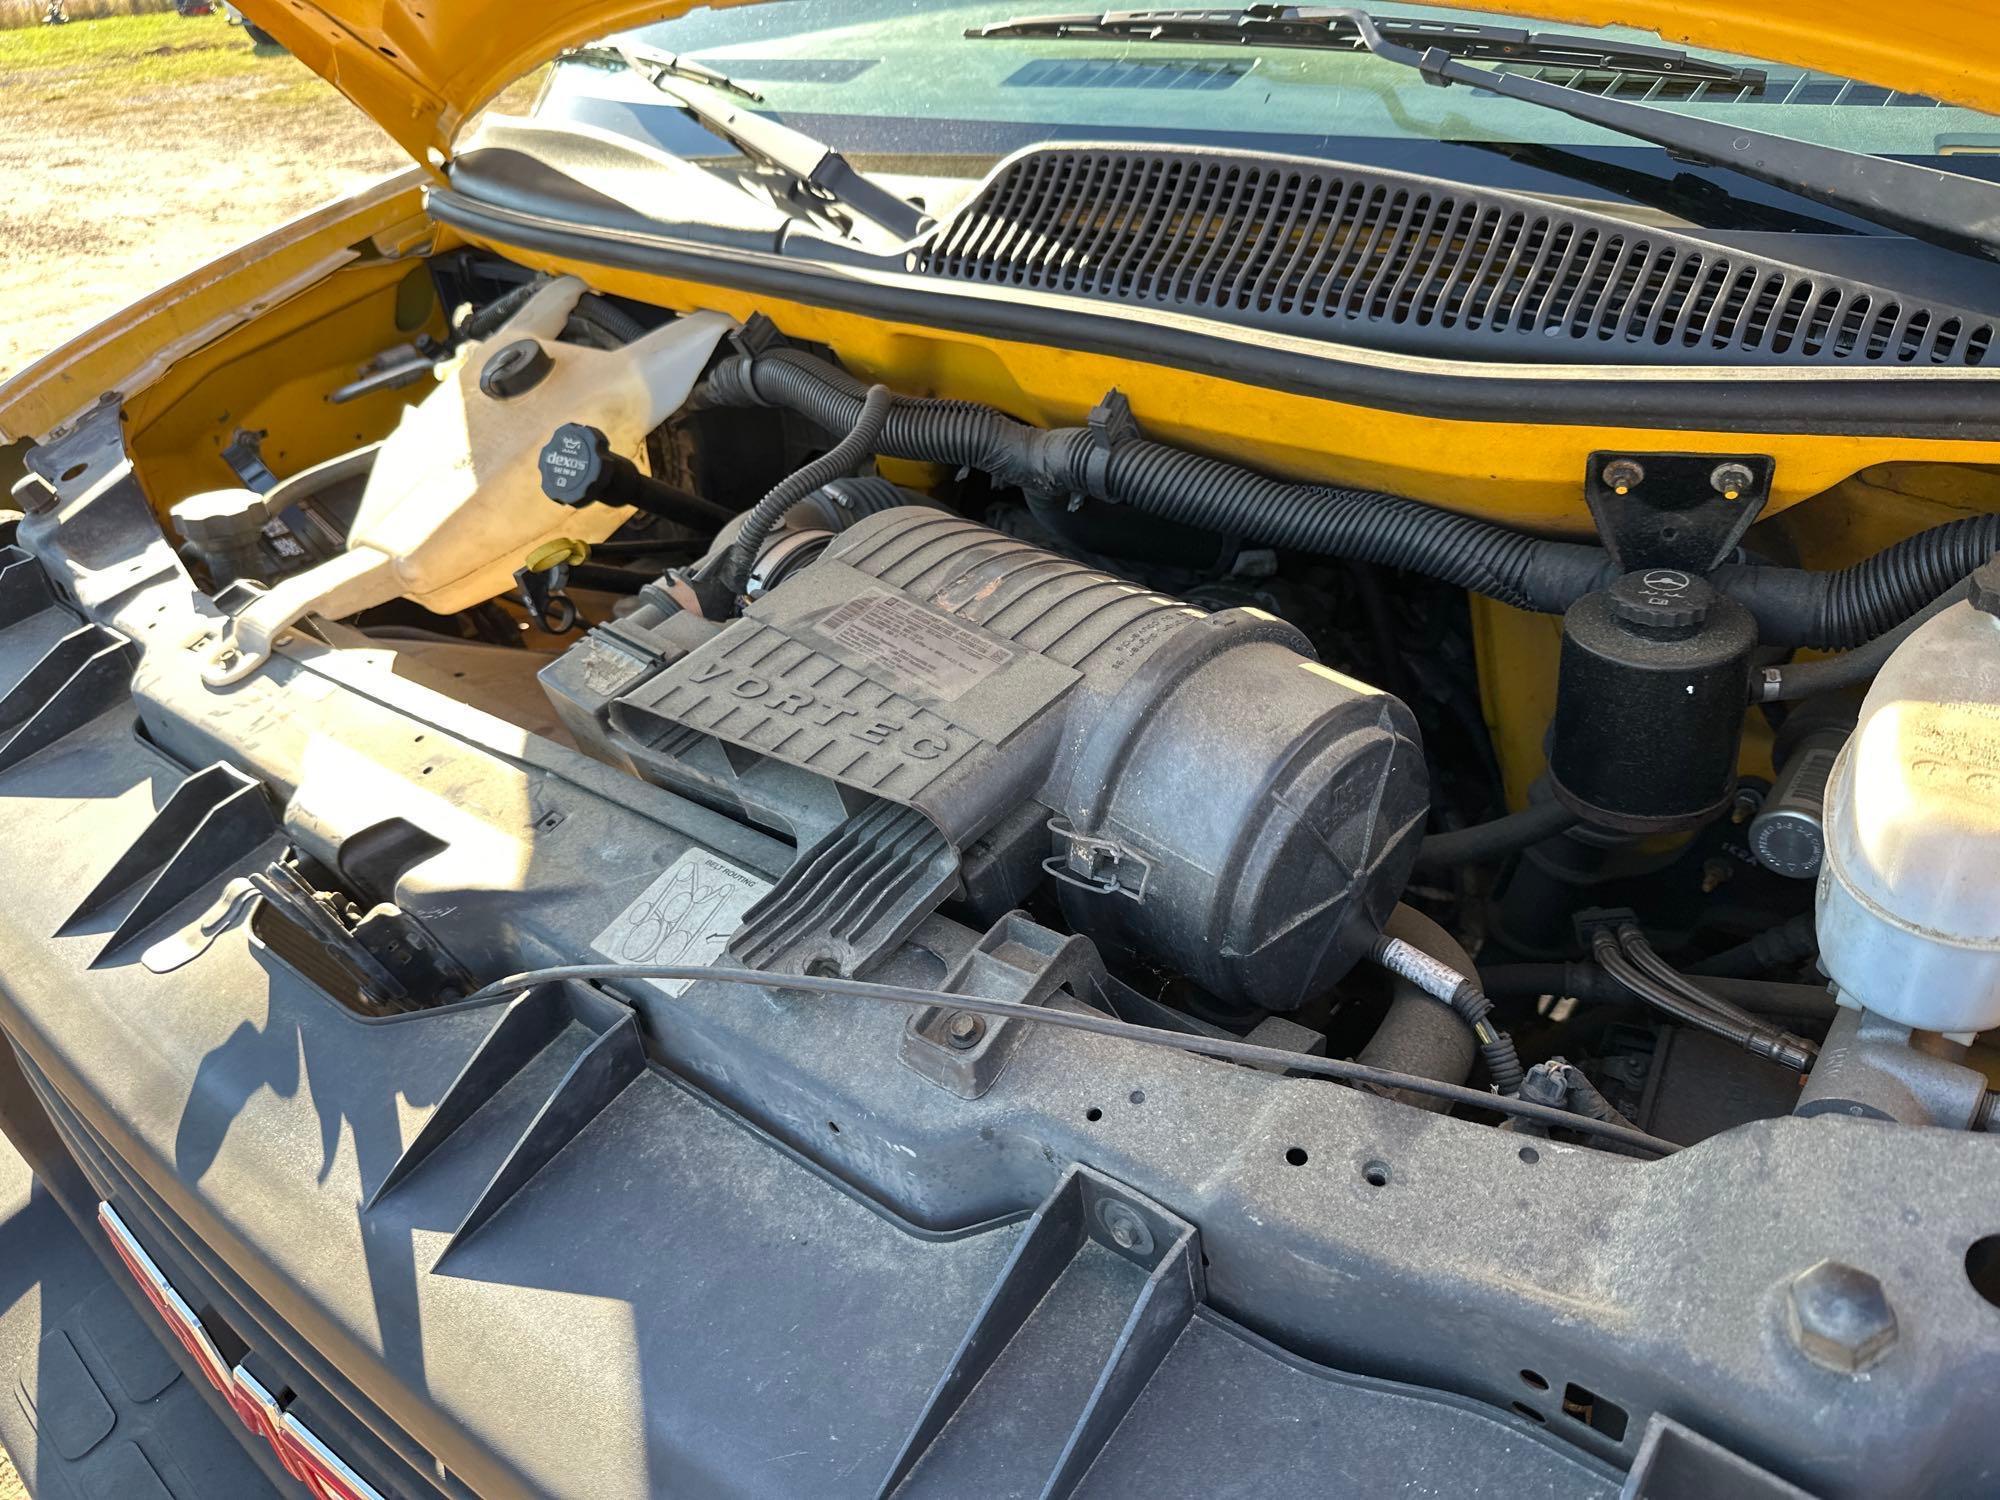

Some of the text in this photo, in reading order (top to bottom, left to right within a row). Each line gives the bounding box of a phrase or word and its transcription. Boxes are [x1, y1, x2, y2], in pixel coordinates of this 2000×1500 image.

[547, 451, 586, 471] dexos
[687, 663, 949, 760] VORTEC
[705, 860, 756, 887] BELT ROUTING
